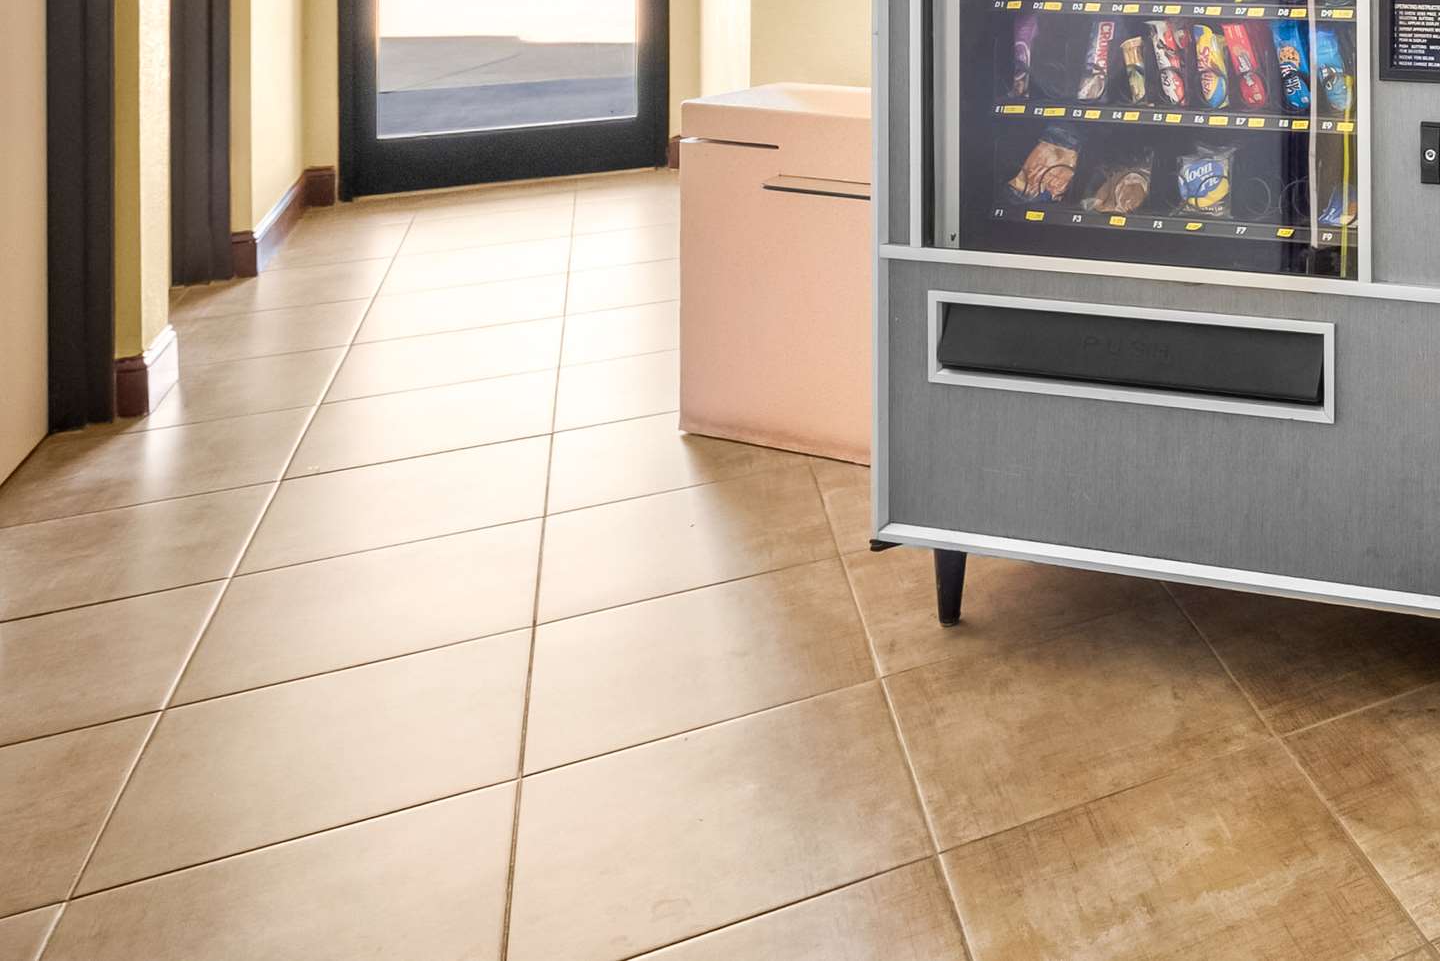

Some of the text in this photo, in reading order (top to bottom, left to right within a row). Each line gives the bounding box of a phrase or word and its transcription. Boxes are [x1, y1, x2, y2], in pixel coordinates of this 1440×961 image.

[1193, 6, 1205, 14] D6
[1235, 7, 1247, 15] D7
[1194, 116, 1205, 124] E6
[1236, 117, 1246, 126] E7
[1322, 122, 1333, 130] E9
[1072, 215, 1082, 223] F3
[1153, 221, 1163, 229] F5
[1236, 227, 1247, 235] F7
[1322, 233, 1333, 241] F9
